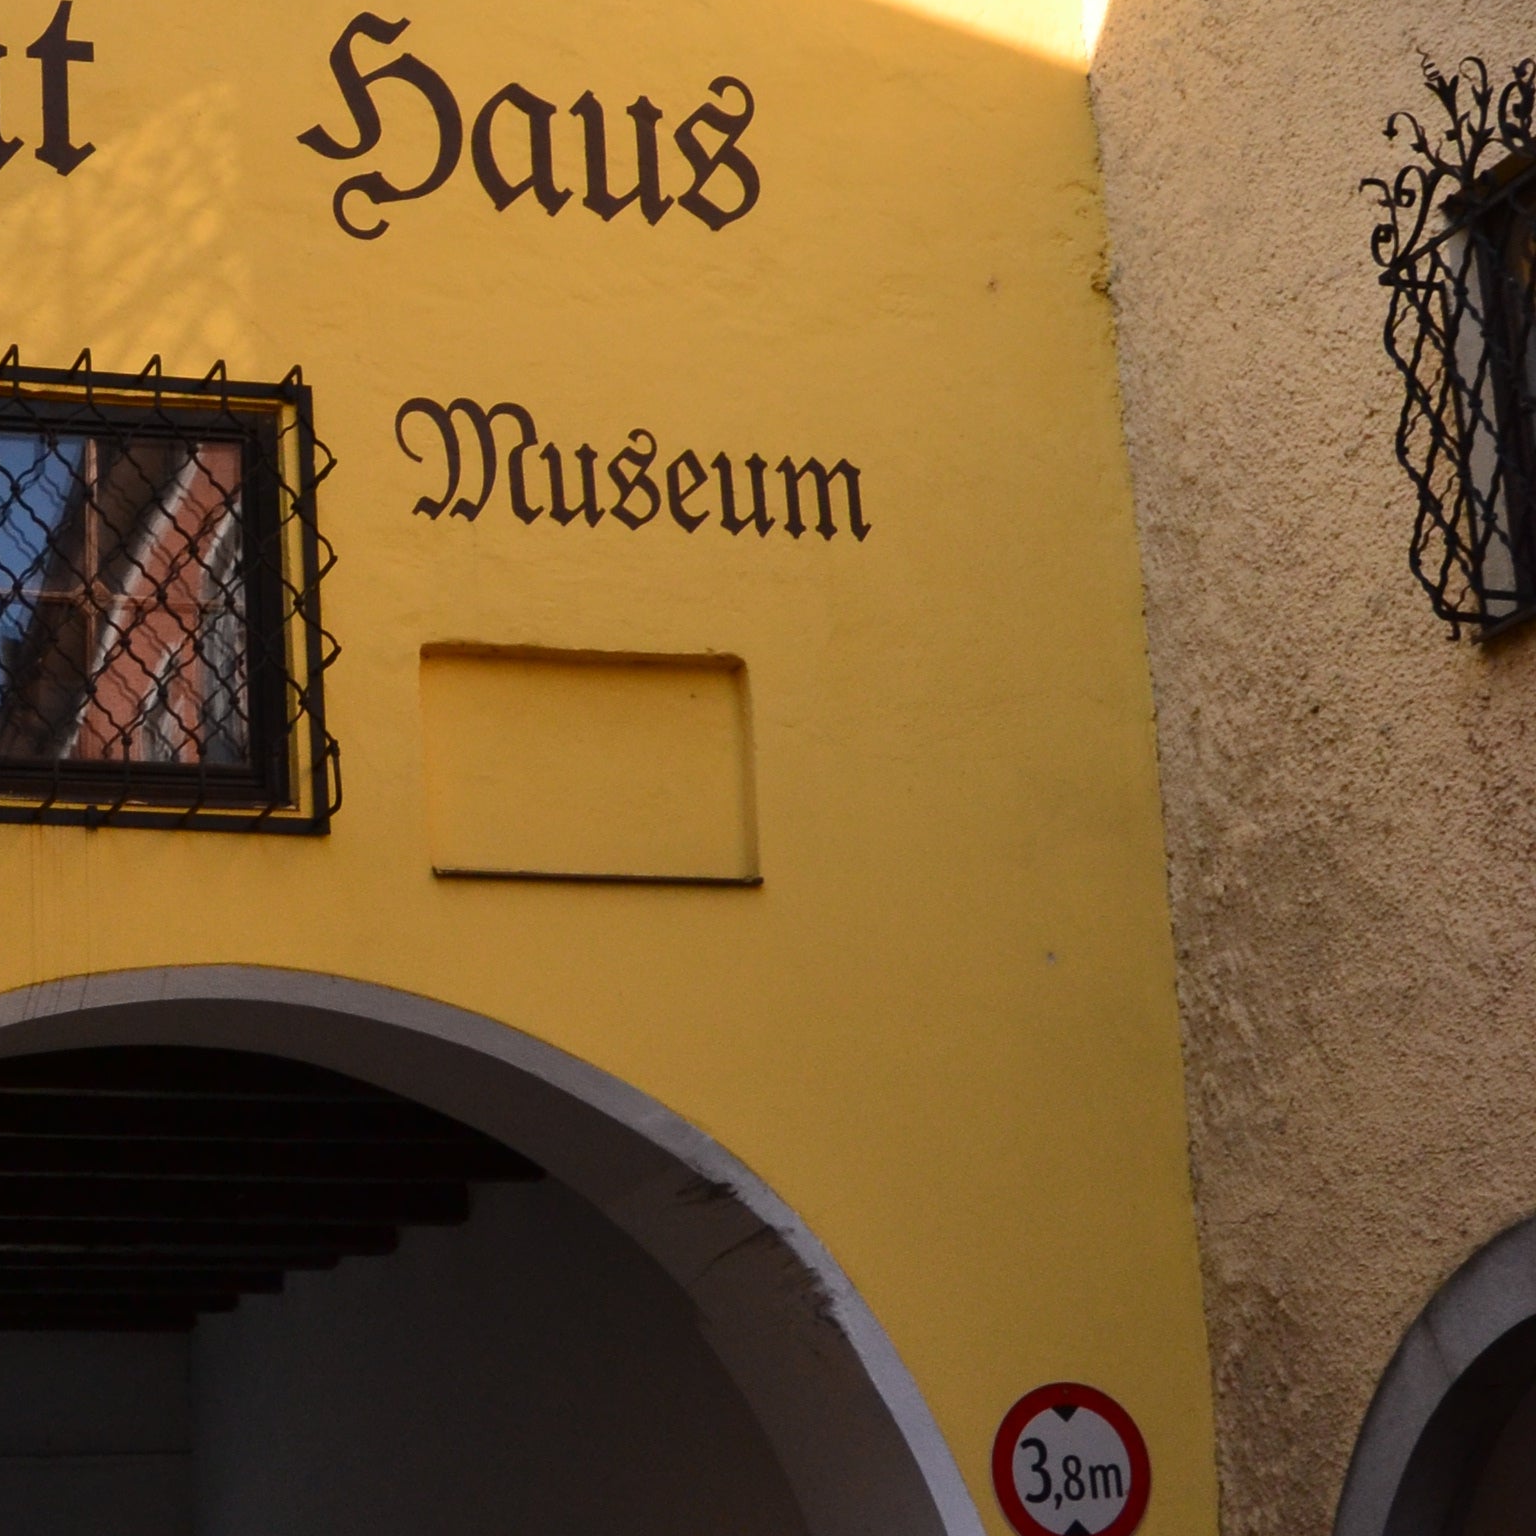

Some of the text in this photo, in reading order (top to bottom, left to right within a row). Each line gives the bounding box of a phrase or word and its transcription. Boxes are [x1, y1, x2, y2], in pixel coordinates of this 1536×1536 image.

[297, 11, 763, 242] Haus
[394, 397, 873, 545] Museum
[1020, 1437, 1124, 1510] 3,8m
